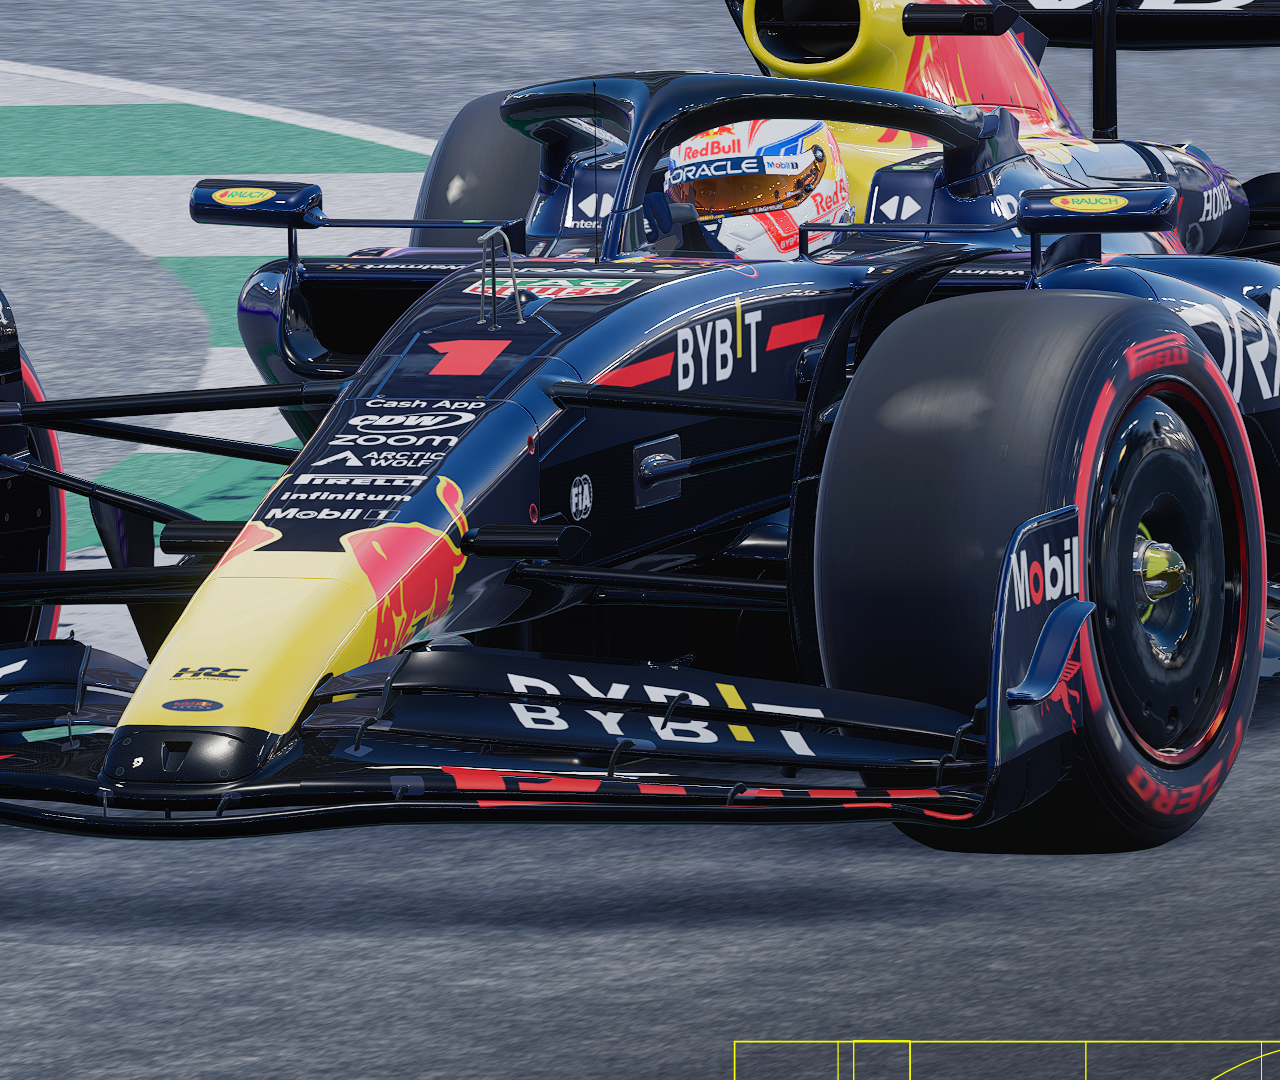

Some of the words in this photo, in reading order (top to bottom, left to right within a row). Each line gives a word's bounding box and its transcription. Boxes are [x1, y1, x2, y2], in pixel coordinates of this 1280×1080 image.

[668, 159, 760, 185] ORACLE
[227, 190, 269, 199] RAUCH
[1071, 197, 1119, 206] RAUCH
[503, 278, 620, 288] TAG
[676, 298, 762, 392] BYBIT
[428, 340, 512, 375] 1
[1125, 332, 1190, 382] PIRELLI
[365, 399, 426, 408] Cash
[432, 399, 487, 410] App
[348, 413, 460, 428] CDW
[328, 434, 459, 446] zoom
[362, 451, 447, 460] ARCTIC
[370, 459, 434, 468] WOLF
[293, 473, 429, 487] PIRELLI
[280, 491, 412, 501] infinitum
[571, 480, 593, 516] FIA
[264, 508, 364, 520] Mobil
[1010, 536, 1079, 612] Mobil
[172, 667, 250, 679] HRC
[507, 673, 824, 757] BYBIT
[1126, 762, 1223, 815] ZERO
